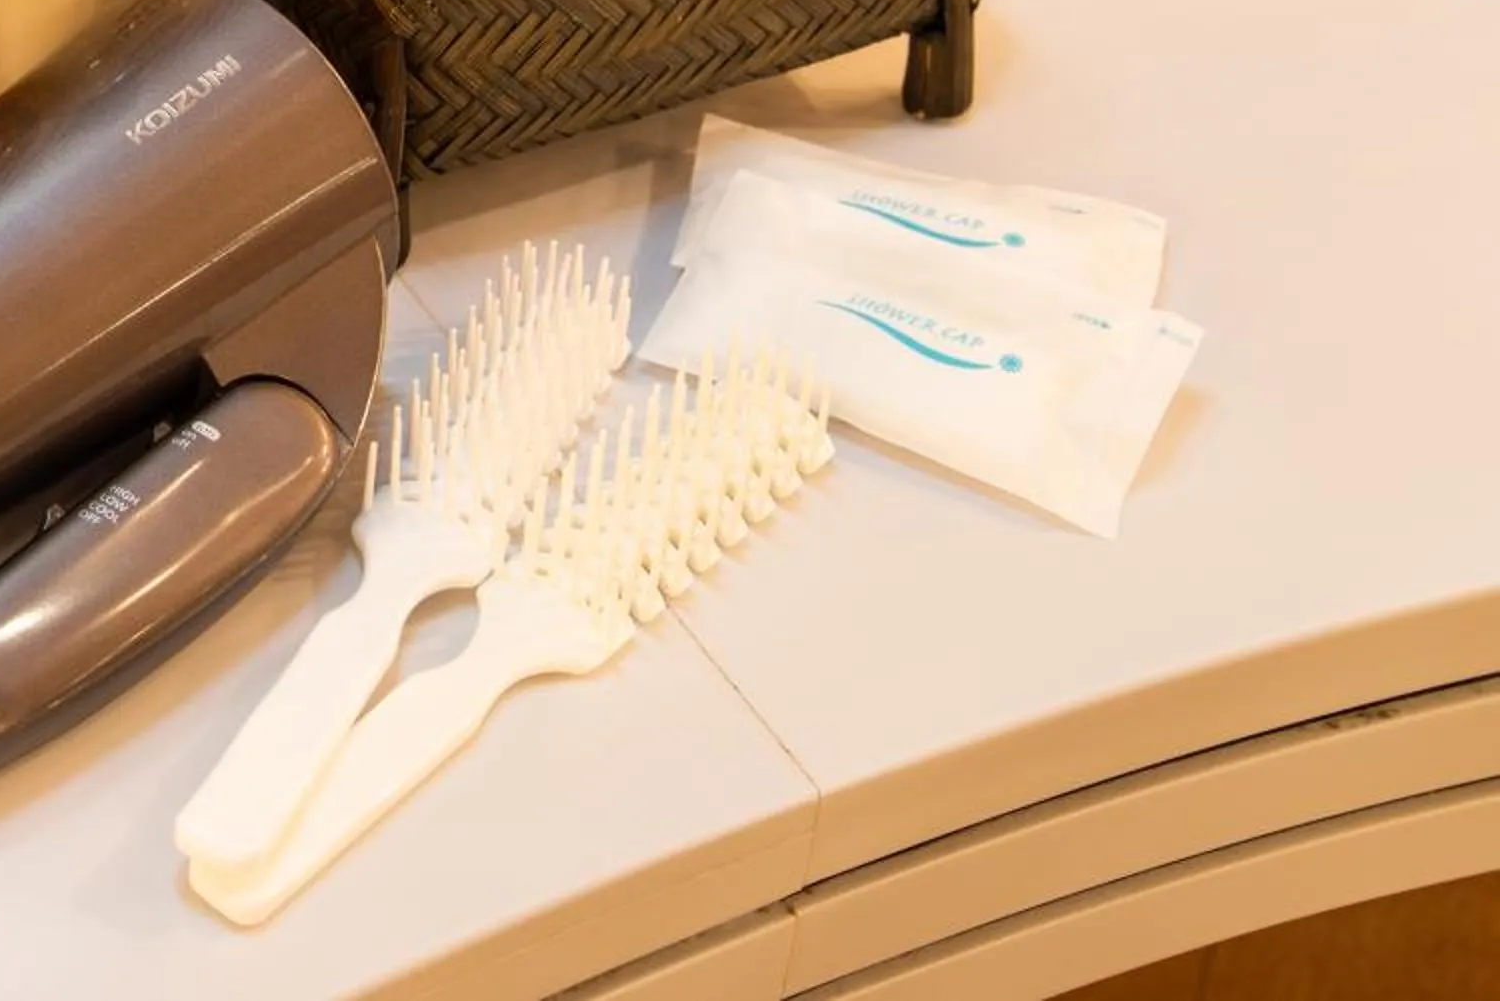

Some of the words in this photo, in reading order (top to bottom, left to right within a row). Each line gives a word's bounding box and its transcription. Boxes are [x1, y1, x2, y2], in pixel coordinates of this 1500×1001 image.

[125, 54, 242, 146] KOIZUMI
[851, 188, 937, 218] SHOWER
[944, 212, 985, 231] CAP
[846, 292, 936, 332] SHOWER
[941, 326, 986, 349] CAP
